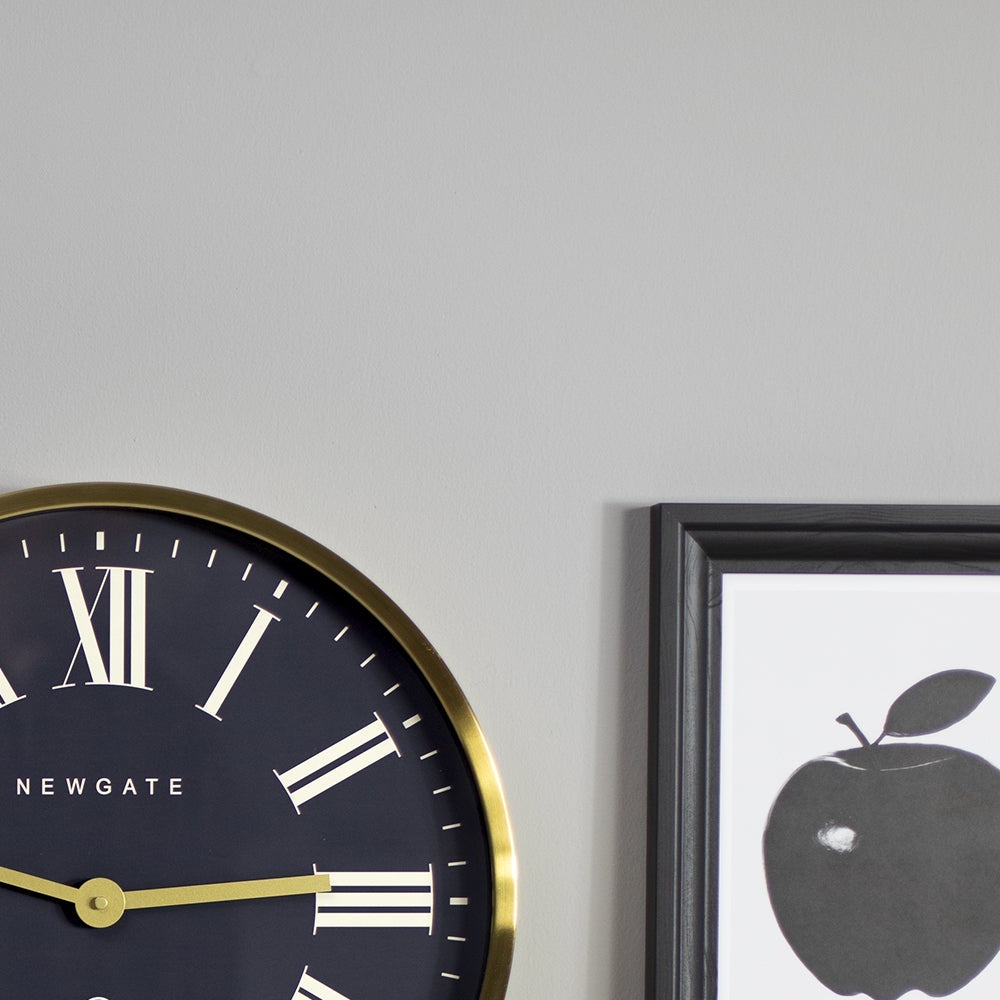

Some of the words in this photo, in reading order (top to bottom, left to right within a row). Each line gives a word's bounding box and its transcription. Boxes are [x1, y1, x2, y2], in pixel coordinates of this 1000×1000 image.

[52, 566, 154, 690] XII
[195, 604, 281, 722] I
[16, 778, 183, 796] NEWGATE
[273, 711, 402, 815] II
[313, 863, 434, 935] III
